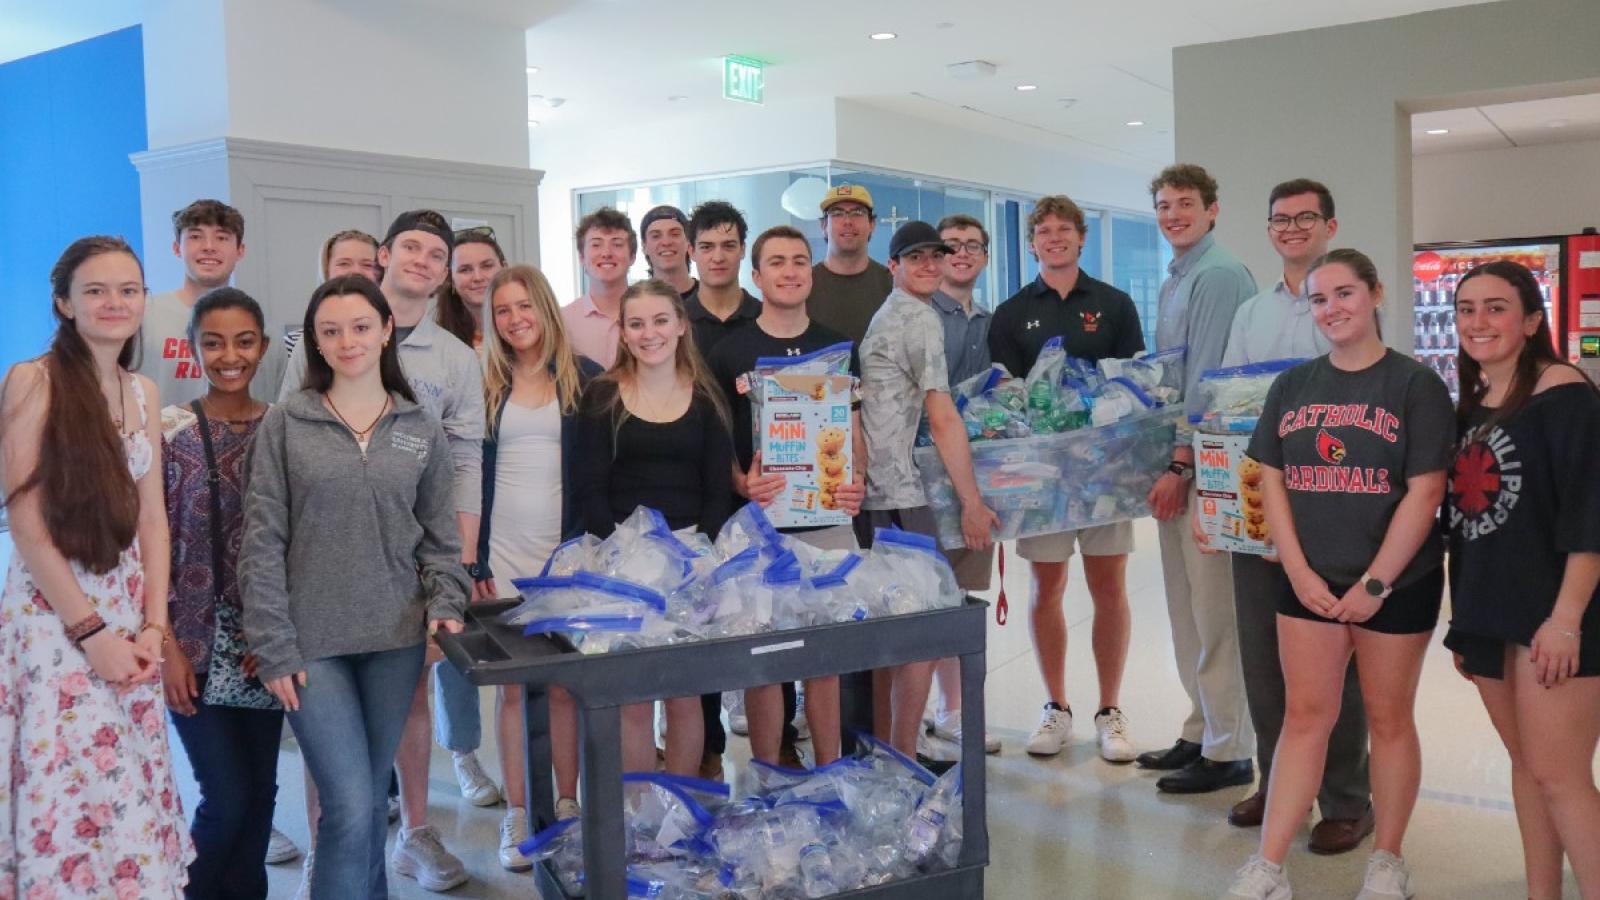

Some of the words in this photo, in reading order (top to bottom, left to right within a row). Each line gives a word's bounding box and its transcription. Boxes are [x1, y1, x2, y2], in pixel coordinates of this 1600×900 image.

[730, 62, 761, 100] EXIT
[1453, 261, 1473, 270] ICE
[833, 407, 845, 418] 20
[1278, 404, 1400, 443] CATHOLIC
[1284, 464, 1391, 494] CARDINALS
